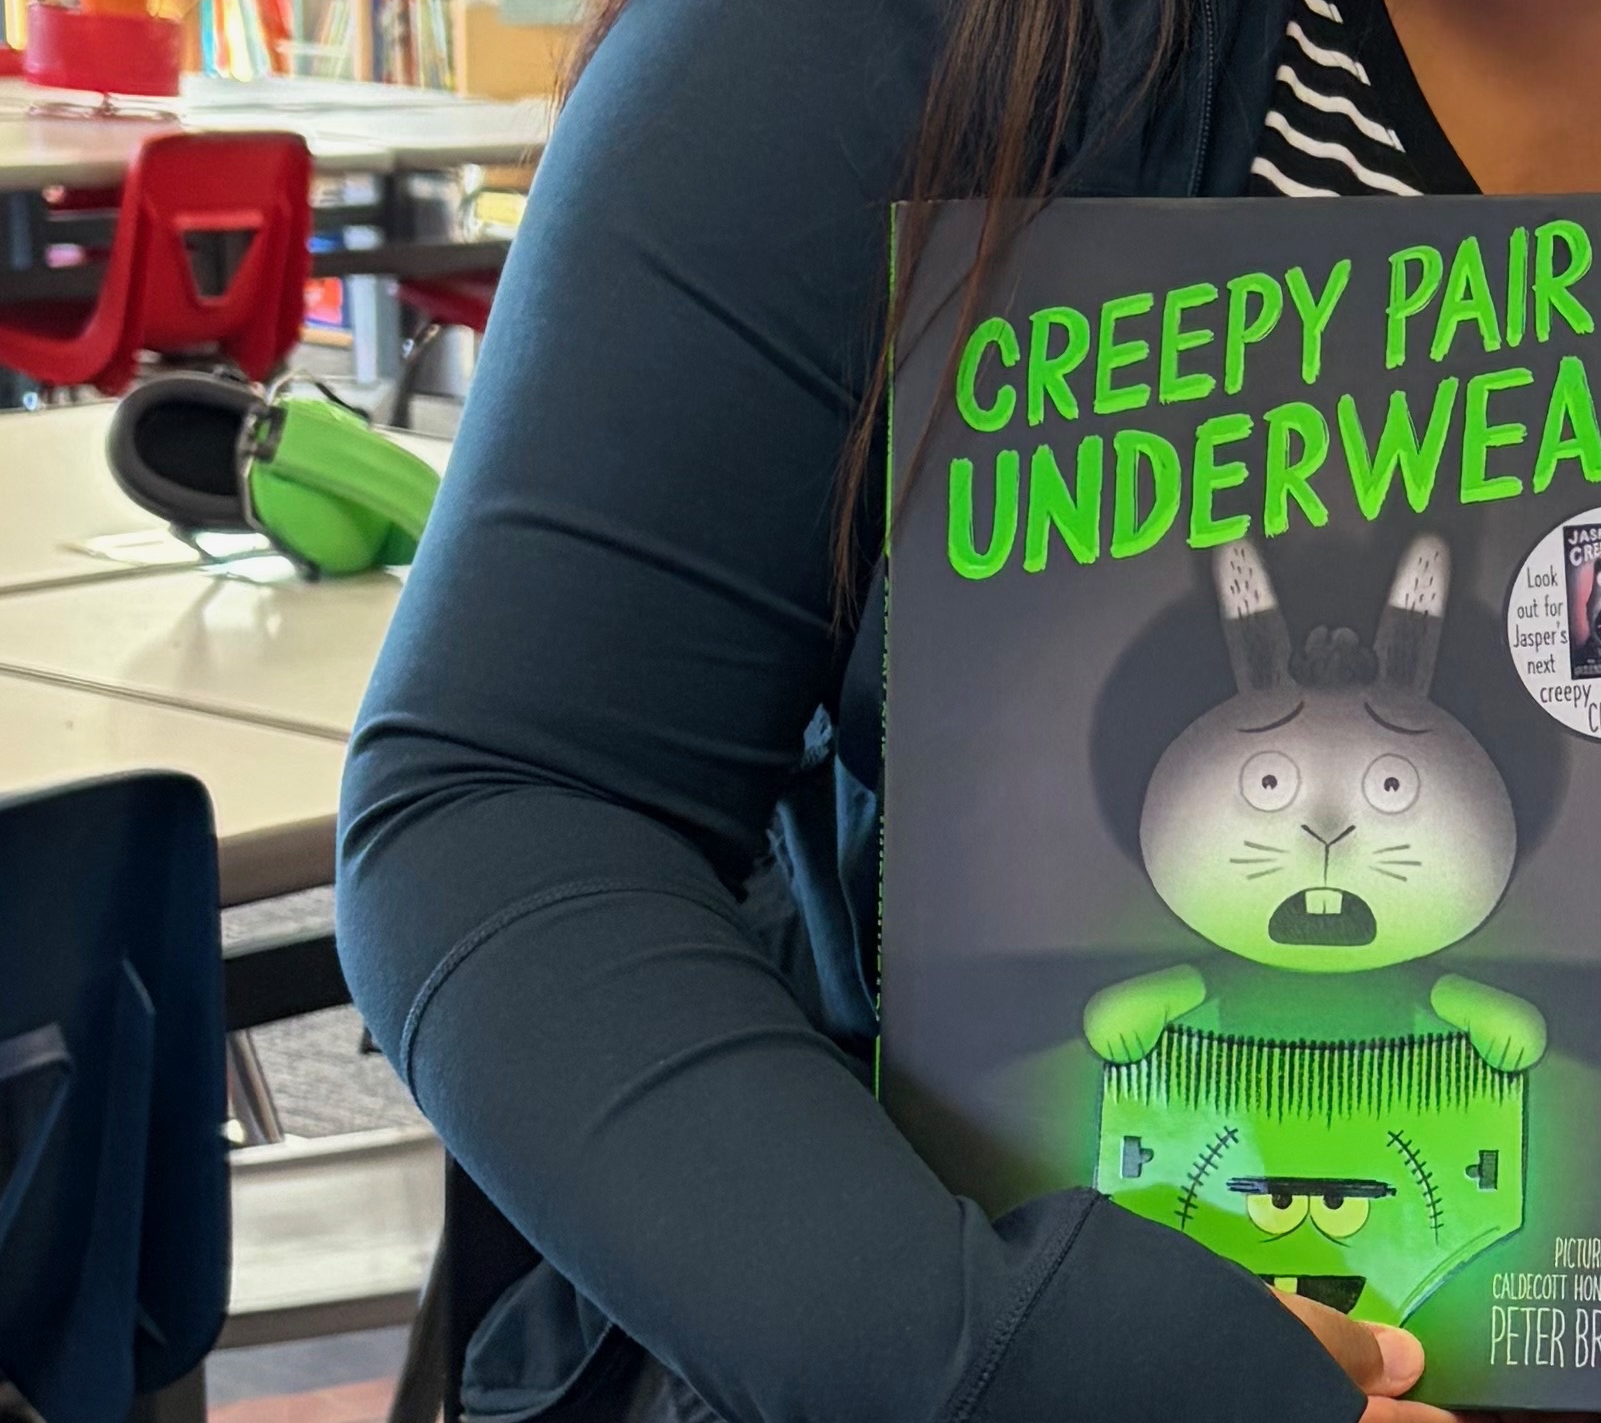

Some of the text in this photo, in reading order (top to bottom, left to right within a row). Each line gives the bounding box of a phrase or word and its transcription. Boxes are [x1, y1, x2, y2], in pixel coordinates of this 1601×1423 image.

[956, 259, 1352, 432] CREEPY
[1386, 219, 1595, 370] PAIR
[1526, 564, 1559, 589] Look
[1517, 593, 1565, 619] out for
[1513, 620, 1568, 652] Jasper's
[1527, 653, 1556, 675] next
[1540, 682, 1592, 708] creepy
[1492, 1272, 1568, 1301] CALDECOTT
[1490, 1305, 1566, 1368] PETER
